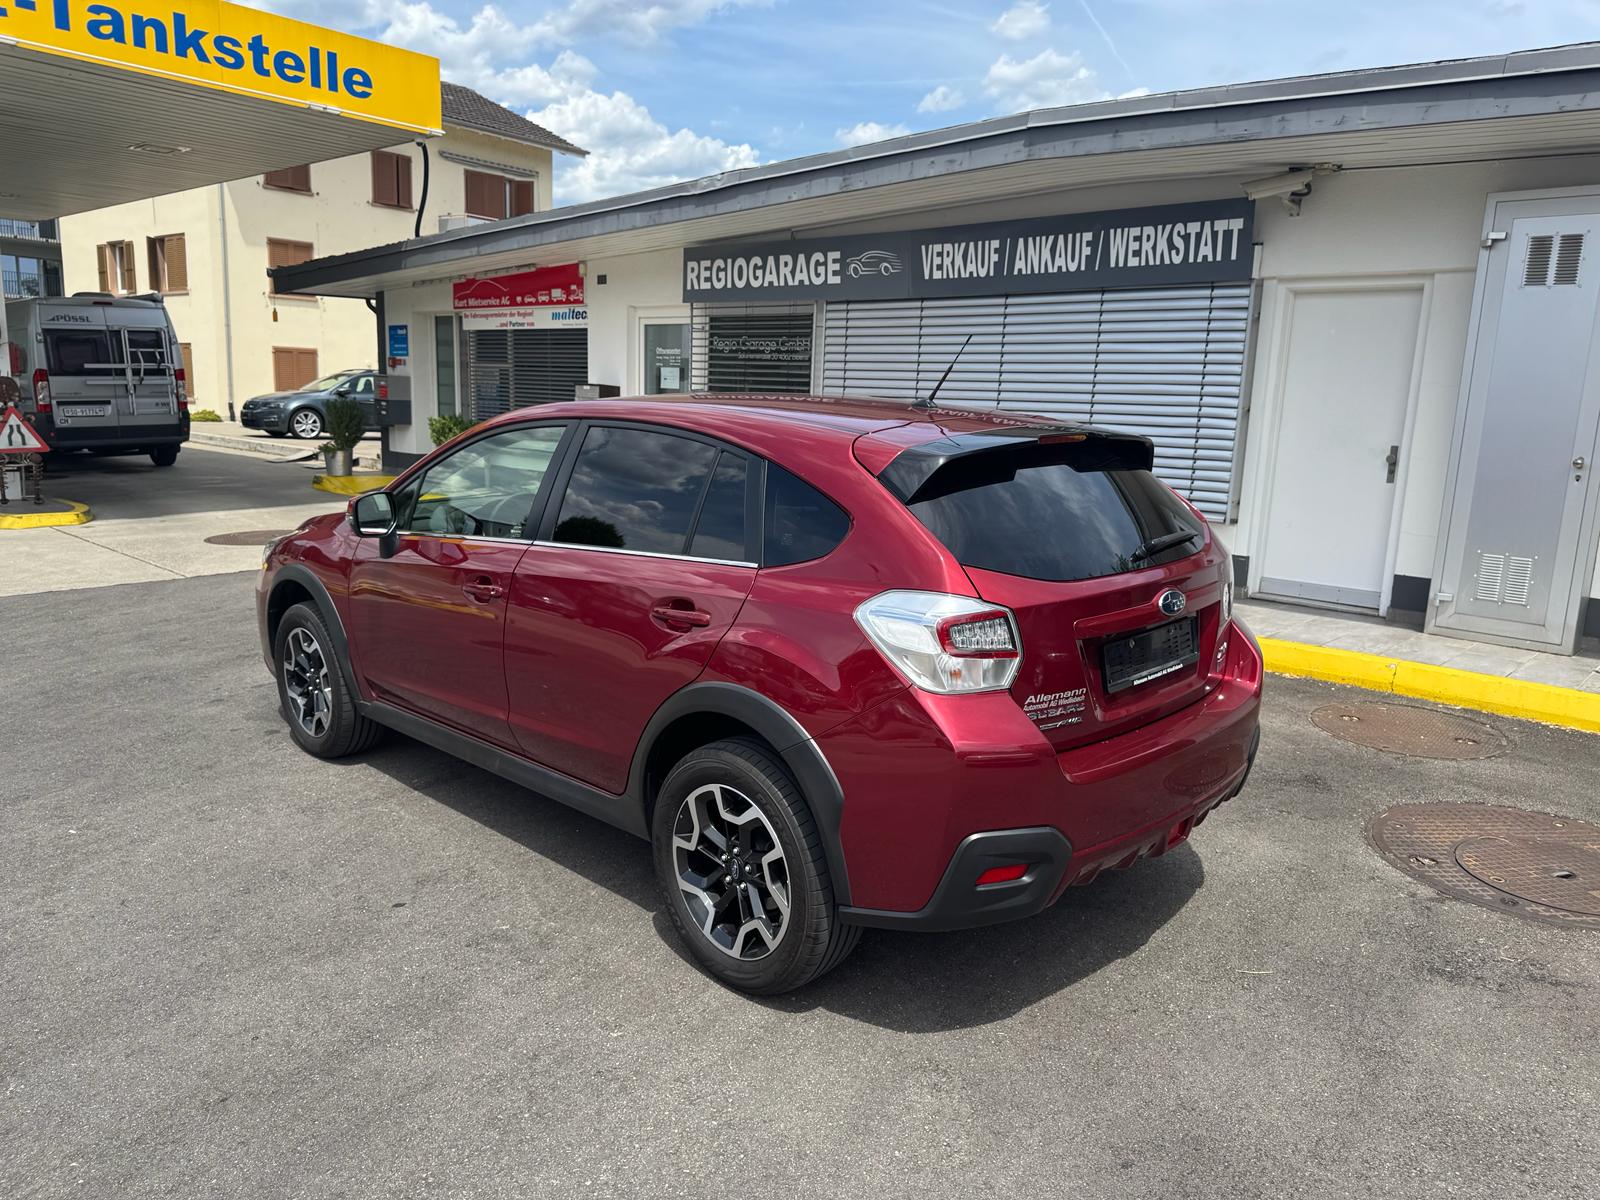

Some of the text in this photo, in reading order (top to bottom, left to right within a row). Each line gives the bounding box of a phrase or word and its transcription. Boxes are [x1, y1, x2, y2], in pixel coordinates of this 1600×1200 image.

[0, 0, 374, 99] -ankstelle
[921, 239, 1000, 280] VERKAUF
[1013, 231, 1093, 276] ANKAUF
[1109, 217, 1244, 269] WERKSTATT
[686, 251, 841, 290] REGIOGARAGE
[501, 296, 510, 305] AG
[56, 313, 92, 322] PÖSSL
[509, 320, 526, 328] Partner
[1024, 687, 1087, 705] Allemann
[1023, 702, 1049, 712] Automobil
[1049, 700, 1058, 708] AG
